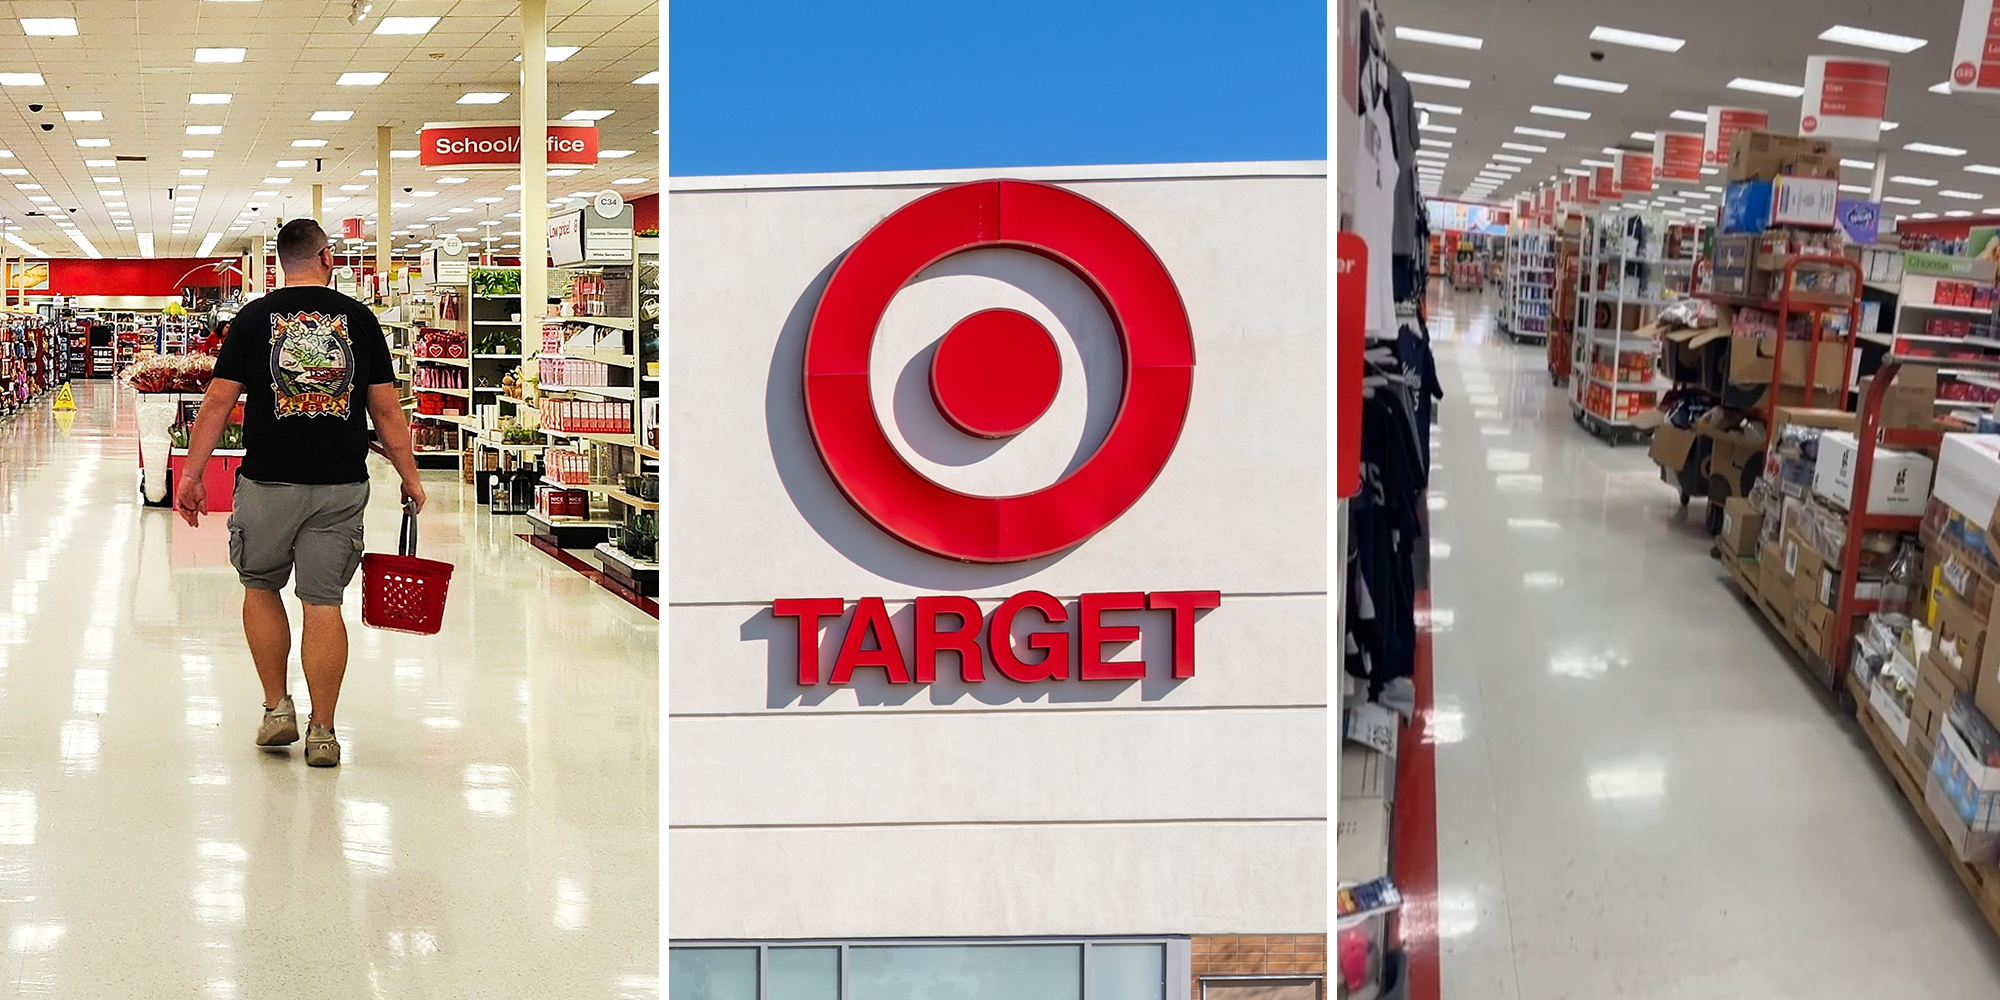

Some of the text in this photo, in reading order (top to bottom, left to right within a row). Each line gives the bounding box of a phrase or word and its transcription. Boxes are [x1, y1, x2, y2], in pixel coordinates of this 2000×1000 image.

[435, 135, 585, 155] School/fice
[600, 198, 617, 206] C34
[772, 589, 1221, 686] TARGET
